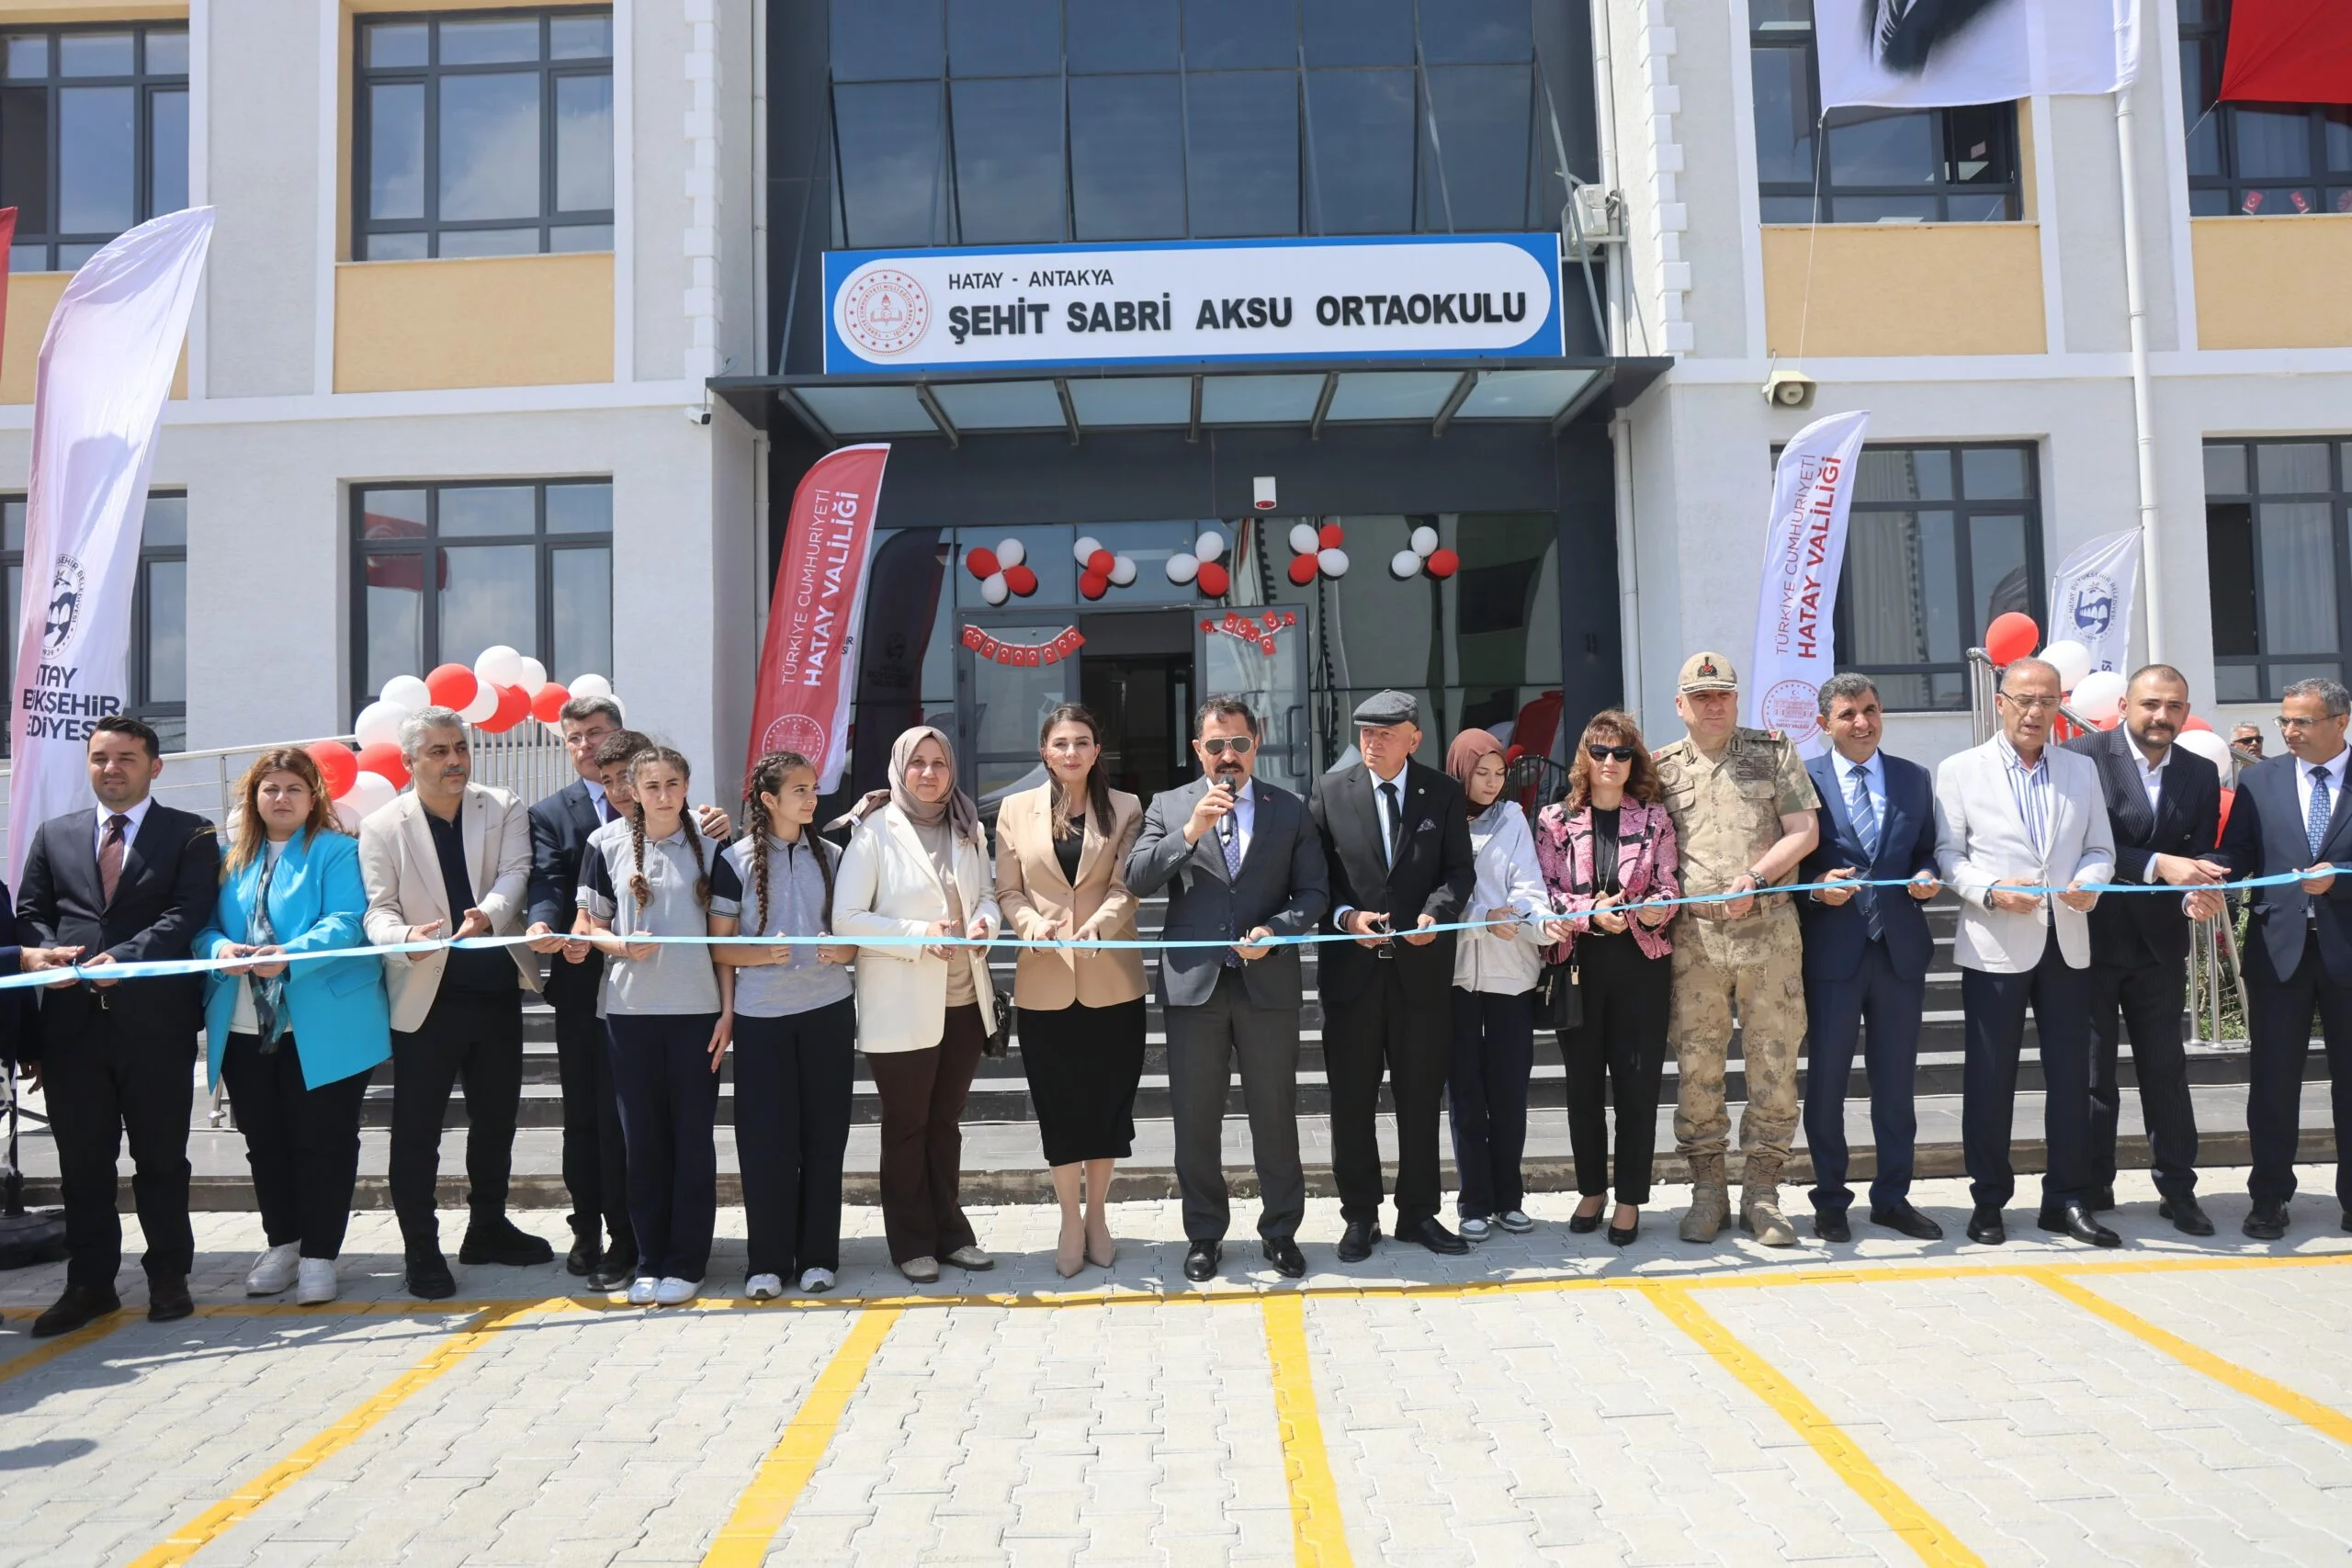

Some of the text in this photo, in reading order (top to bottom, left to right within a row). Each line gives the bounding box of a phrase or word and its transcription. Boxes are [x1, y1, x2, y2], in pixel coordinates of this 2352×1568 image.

[948, 272, 1003, 289] HATAY
[1028, 269, 1114, 288] ANTAKYA
[948, 291, 1526, 344] ŞEHİT SABRİ AKSU ORTAOKULU
[782, 488, 831, 685] TÜRKİYE CUMHURİYETİ
[803, 491, 860, 687] HATAY VALİLİĞİ
[1775, 454, 1815, 655] TÜRKİYE CUMHURİYETİ
[1798, 456, 1841, 659] HATAY VALİLİĞİ
[36, 664, 78, 689] TAY
